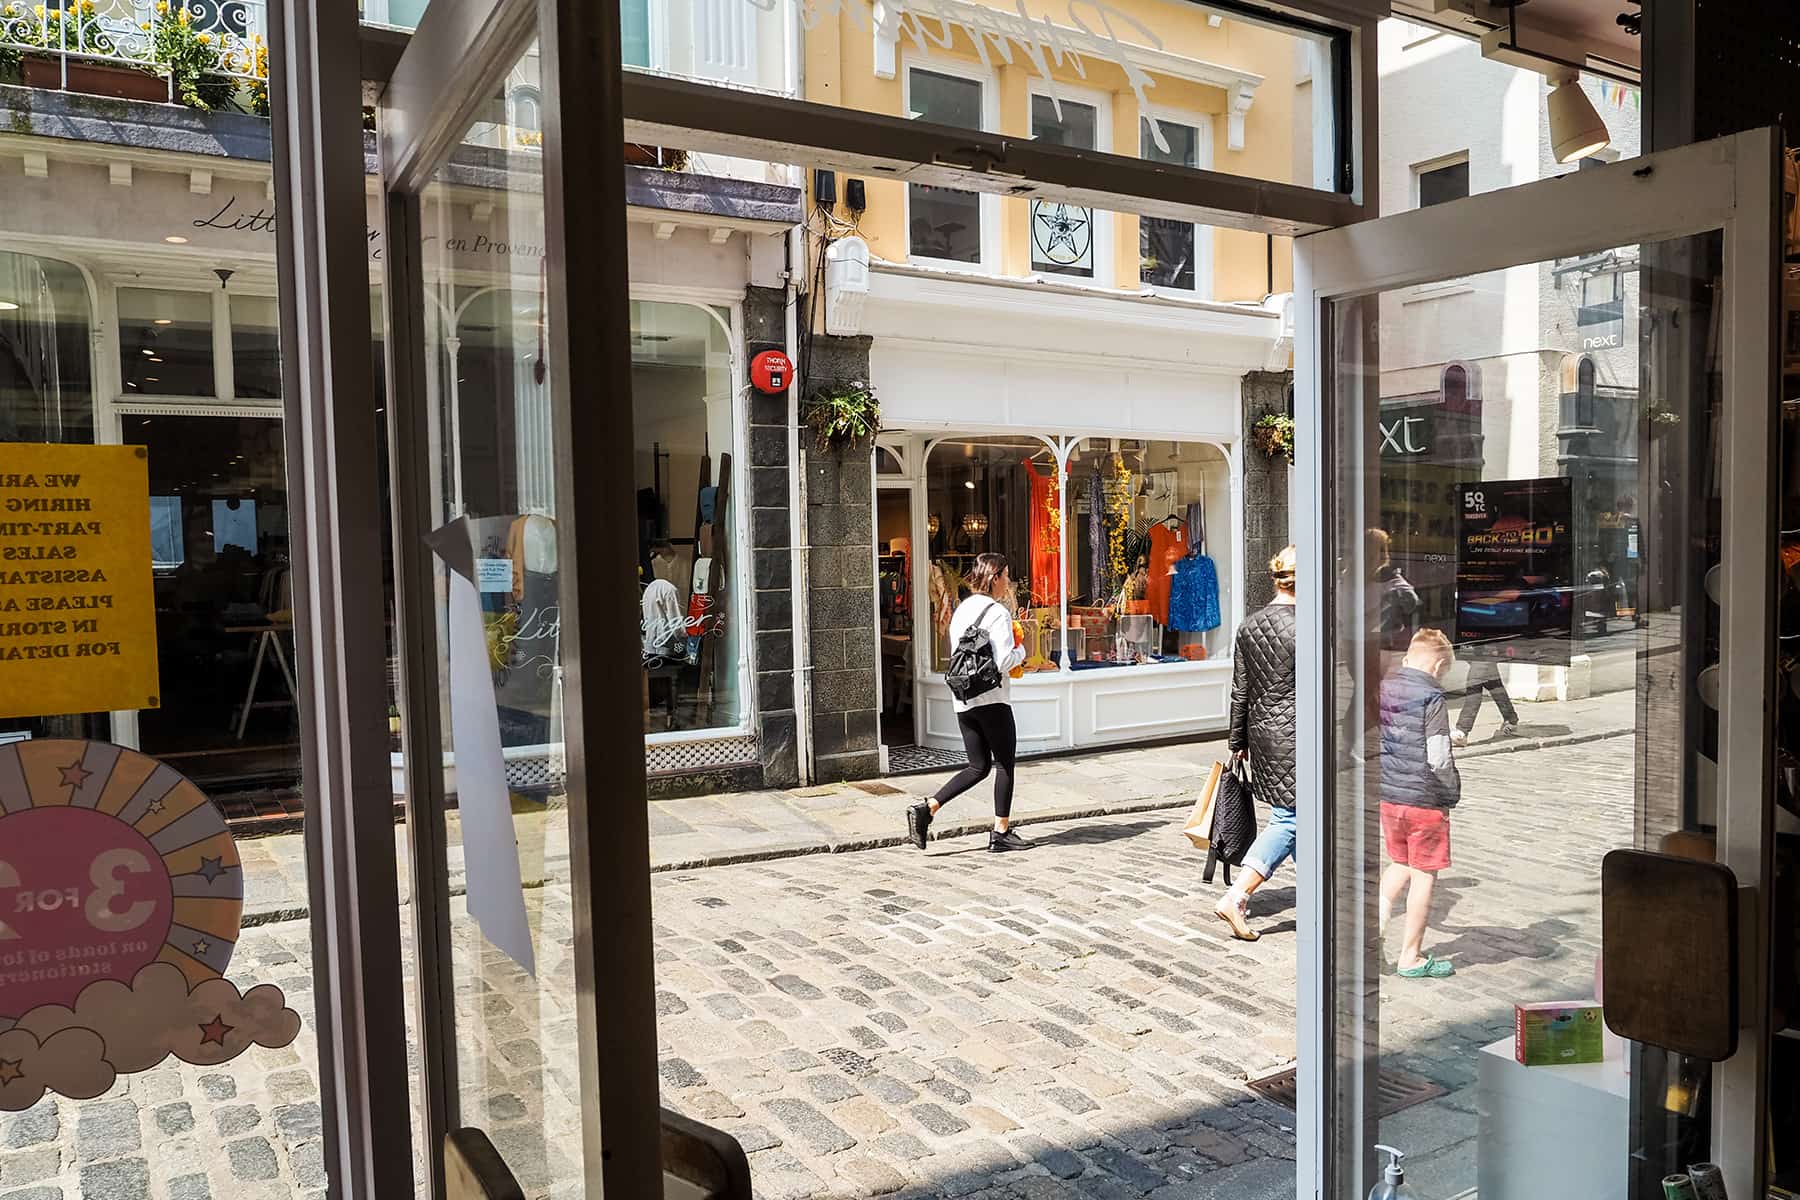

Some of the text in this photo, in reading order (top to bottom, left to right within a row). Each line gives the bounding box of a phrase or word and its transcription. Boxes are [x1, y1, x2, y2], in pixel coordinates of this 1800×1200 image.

[445, 238, 467, 252] en
[1583, 334, 1617, 350] next
[1467, 533, 1501, 545] BACK
